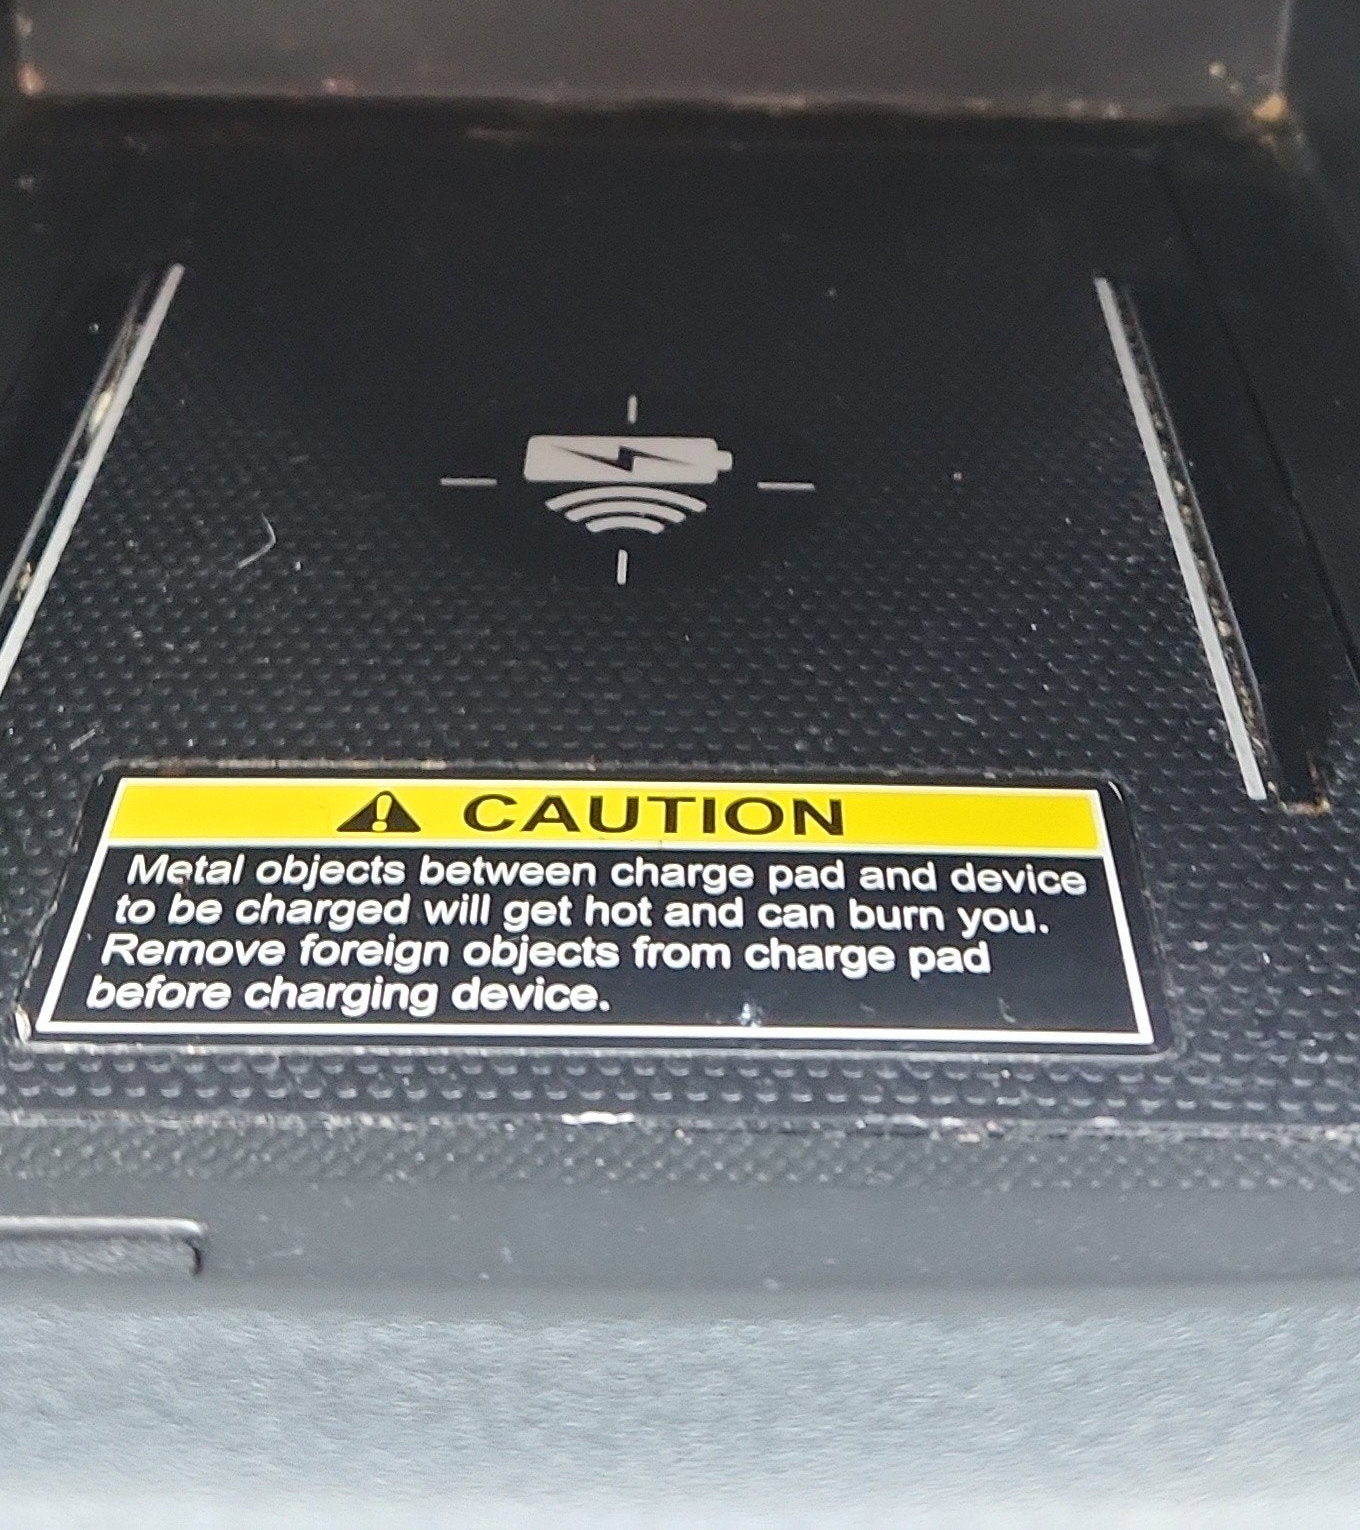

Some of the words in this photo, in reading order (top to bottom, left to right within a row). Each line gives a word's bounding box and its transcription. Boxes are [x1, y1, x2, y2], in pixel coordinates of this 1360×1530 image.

[463, 794, 845, 835] CAUTION
[127, 853, 244, 884] Metal
[256, 853, 406, 889] objects
[419, 853, 596, 886] between
[611, 856, 754, 893] charge
[769, 858, 845, 892] pad
[859, 859, 936, 890] and
[951, 861, 1087, 894] device
[115, 893, 155, 923] to
[167, 892, 223, 923] be
[236, 892, 410, 931] charged
[423, 892, 490, 925] will
[503, 896, 573, 932] get
[586, 894, 652, 926] hot
[664, 895, 743, 927] and
[757, 903, 835, 928] can
[849, 897, 945, 931] burn
[958, 907, 1049, 938] you.
[101, 932, 286, 965] Remove
[299, 932, 449, 972] foreign
[462, 932, 620, 972] objects
[633, 935, 731, 967] from
[744, 936, 895, 978] charge
[910, 941, 991, 978] pad
[86, 974, 232, 1009] before
[244, 975, 439, 1016] charging
[451, 976, 610, 1011] device.
